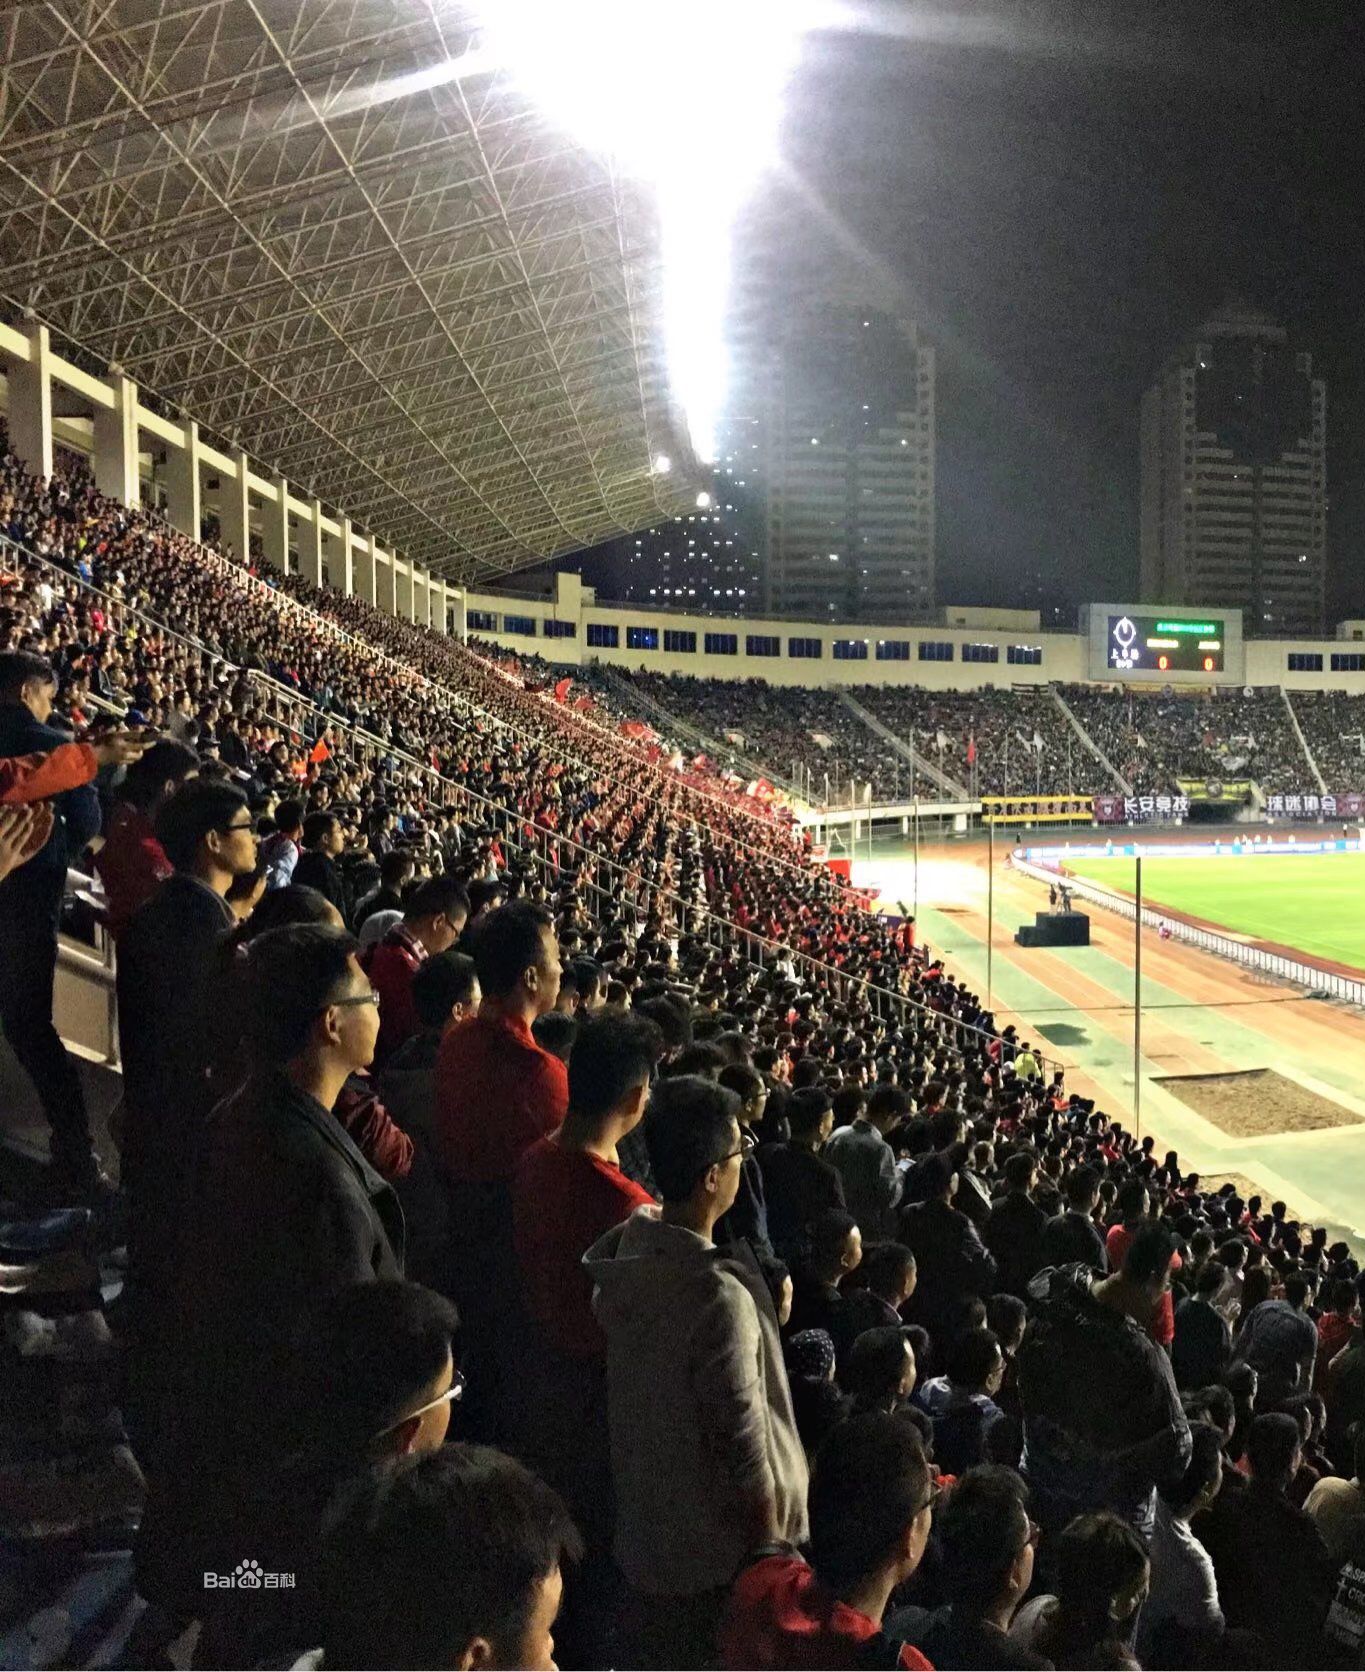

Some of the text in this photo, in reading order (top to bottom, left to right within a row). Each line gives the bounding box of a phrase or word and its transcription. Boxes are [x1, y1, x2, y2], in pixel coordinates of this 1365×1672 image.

[1124, 796, 1188, 813] 长安竞技
[1267, 795, 1336, 811] 球迷协会
